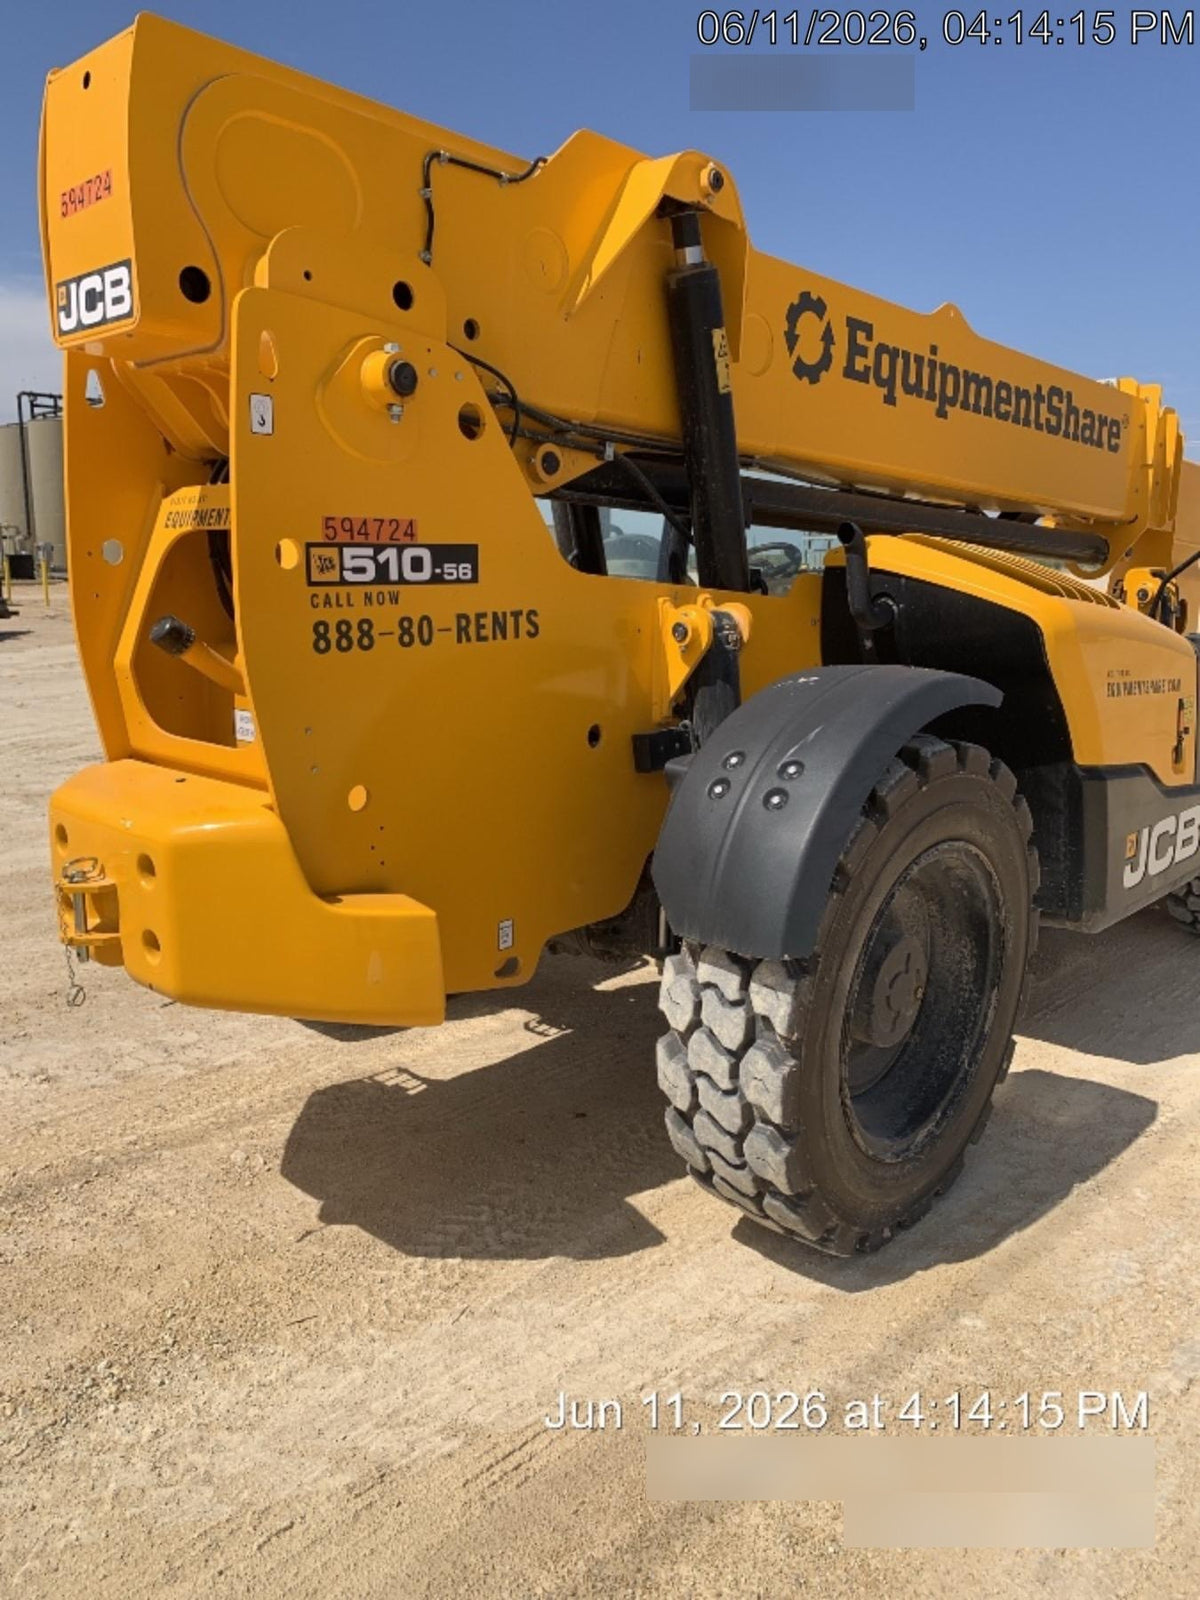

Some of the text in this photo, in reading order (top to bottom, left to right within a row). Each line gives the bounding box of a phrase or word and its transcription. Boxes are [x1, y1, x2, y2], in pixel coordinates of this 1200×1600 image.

[61, 172, 112, 218] 594724
[59, 265, 132, 332] JCB
[165, 507, 231, 529] EQUIPMENT
[324, 516, 416, 542] 594724
[310, 590, 400, 609] CALL NOW
[312, 609, 540, 655] 888-80-RENTS
[1123, 805, 1200, 889] JCB
